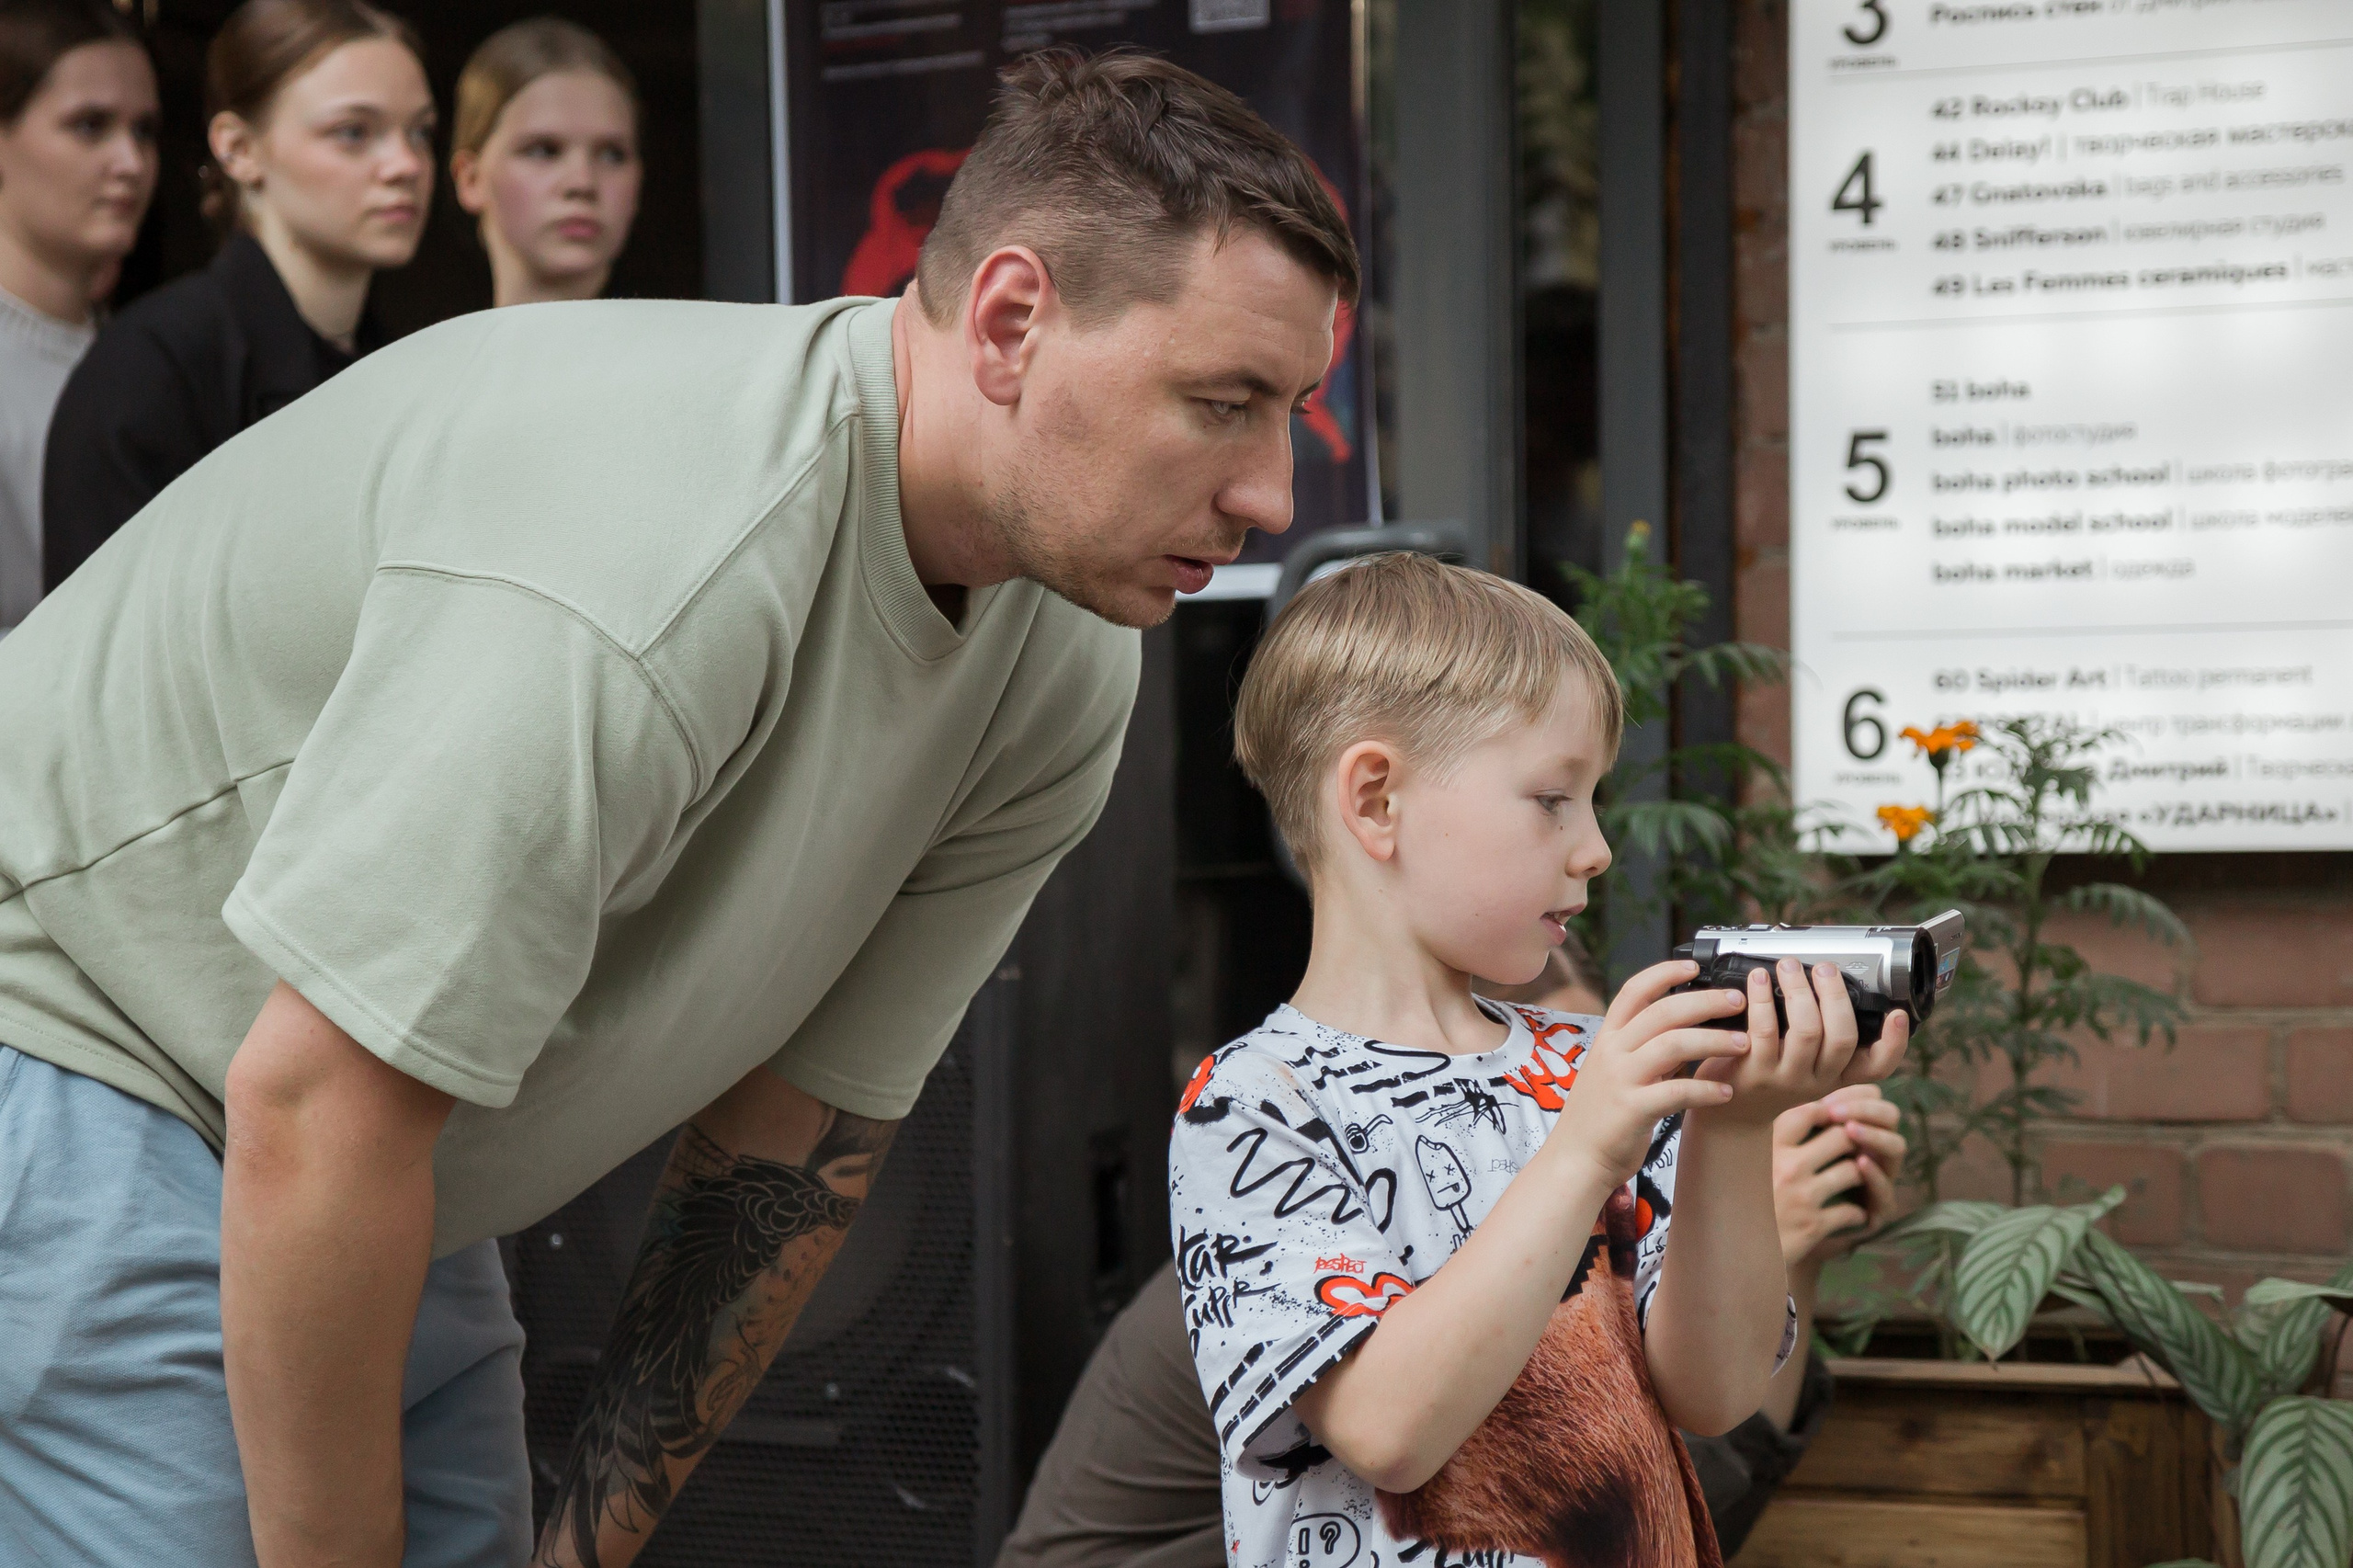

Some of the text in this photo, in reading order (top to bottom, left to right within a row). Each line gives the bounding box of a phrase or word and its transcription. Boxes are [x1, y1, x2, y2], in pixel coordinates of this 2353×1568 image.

[1842, 0, 1889, 44] 3
[2068, 88, 2131, 112] Club
[1830, 149, 1882, 226] 4
[1972, 274, 2016, 296] Les
[2023, 268, 2131, 294] Femmes
[1846, 430, 1890, 503] 5
[2086, 461, 2171, 487] school
[2003, 511, 2084, 536] model
[2089, 508, 2174, 532] school
[2266, 504, 2353, 528] моделе
[2003, 558, 2093, 582] market
[1974, 667, 2059, 694] Spider
[2066, 665, 2109, 689] Art
[1842, 690, 1889, 759] 6
